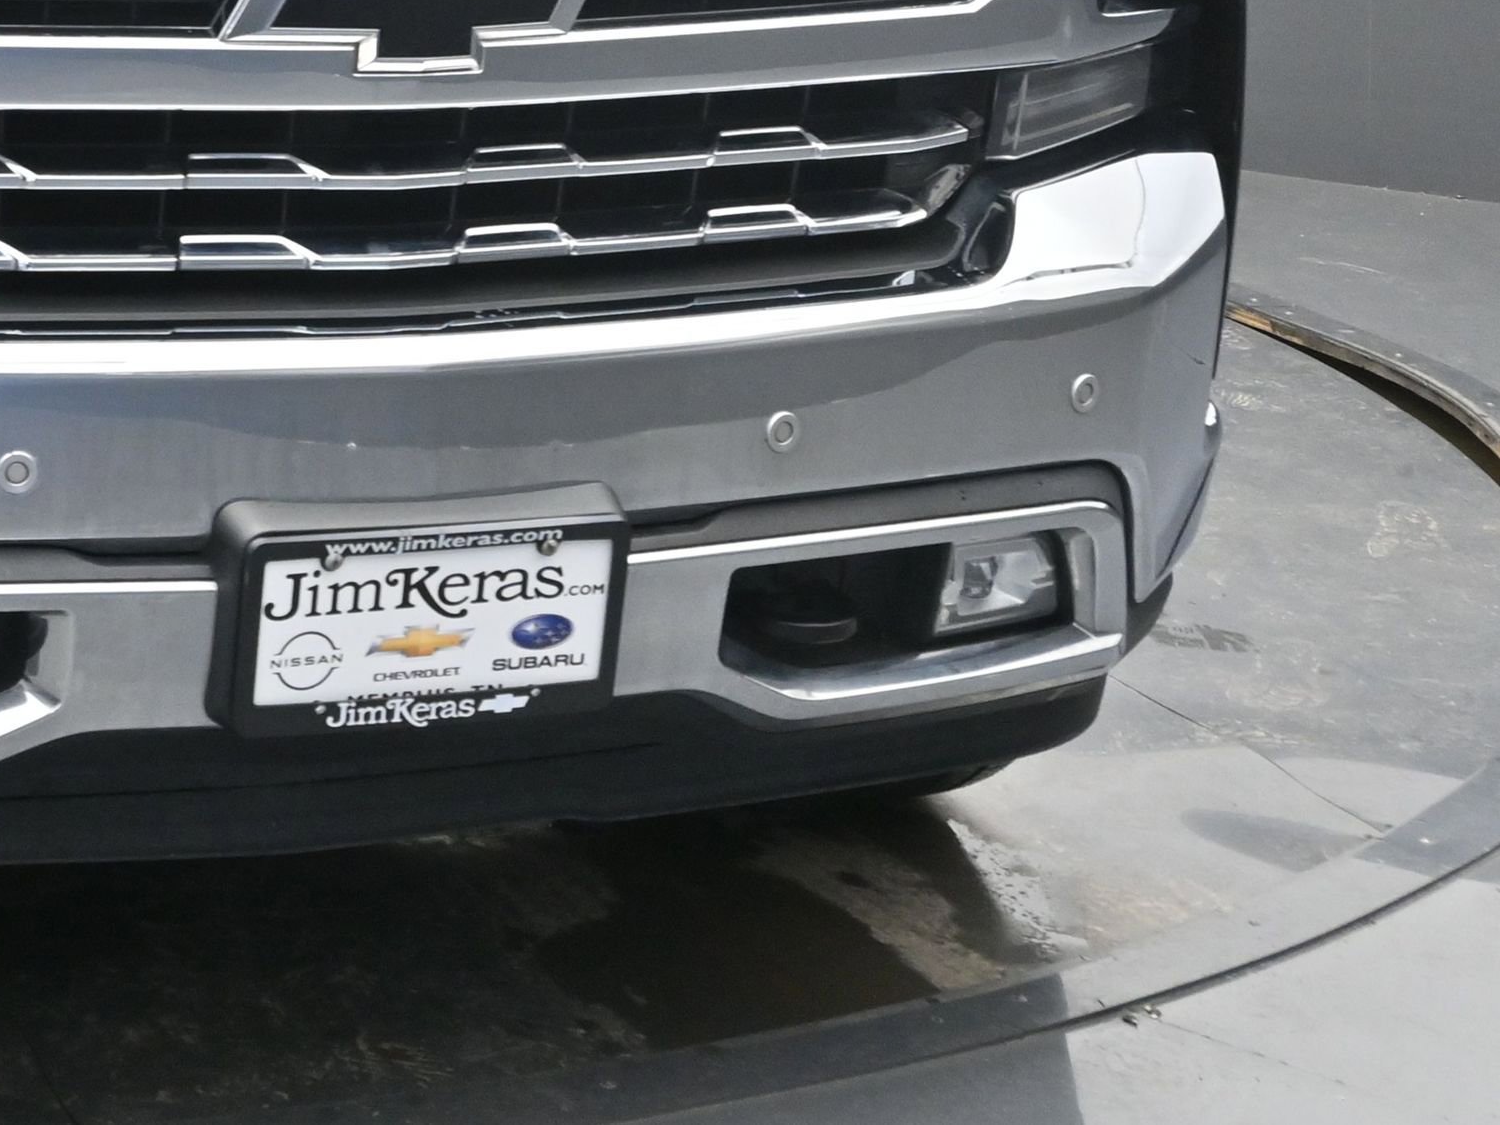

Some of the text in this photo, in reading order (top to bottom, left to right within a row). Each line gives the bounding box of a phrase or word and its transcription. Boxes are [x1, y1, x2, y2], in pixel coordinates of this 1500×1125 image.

[325, 528, 563, 555] www.jimkeras.com
[270, 654, 344, 669] NISSAN
[492, 653, 586, 672] SUBARU
[373, 667, 461, 682] CHEVROLET
